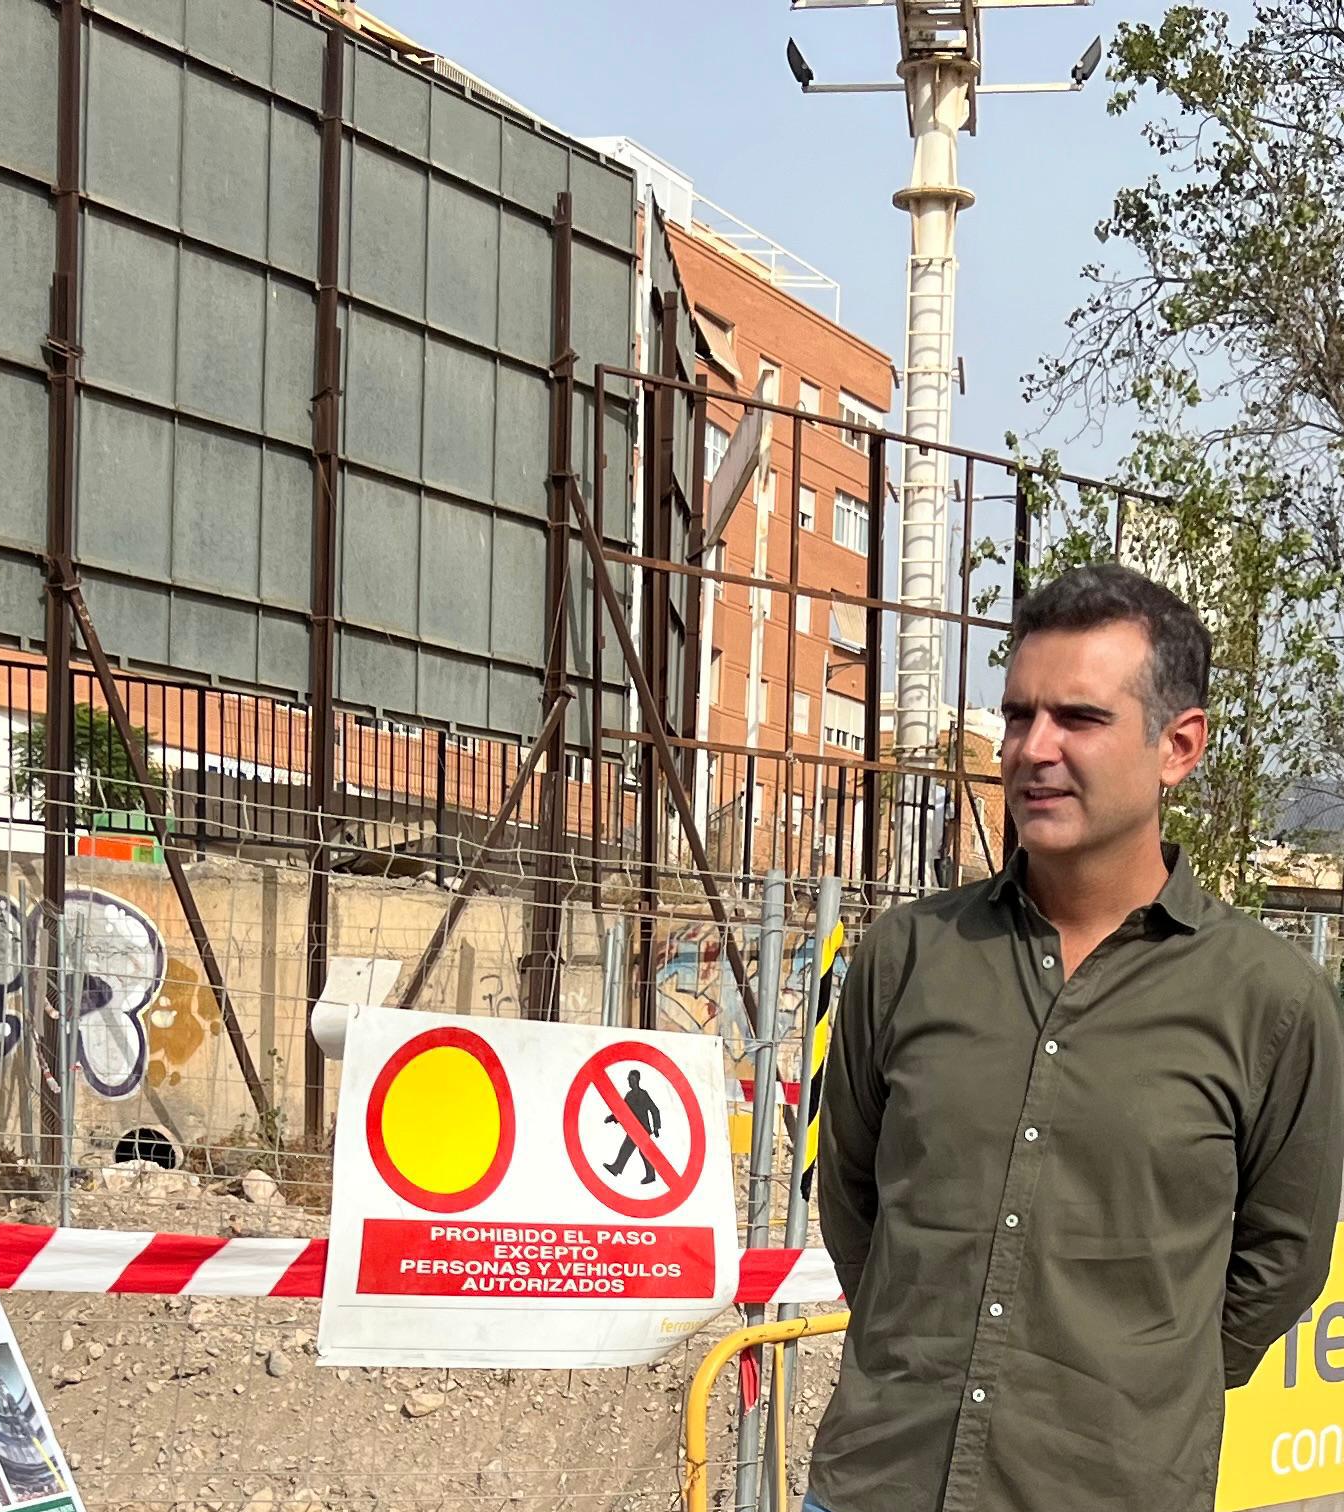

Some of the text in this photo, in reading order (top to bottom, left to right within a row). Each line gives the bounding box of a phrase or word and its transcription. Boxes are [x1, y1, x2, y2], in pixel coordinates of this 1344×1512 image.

[430, 1227, 657, 1246] PROHIBIDO EL PASO
[494, 1245, 598, 1260] EXCEPTO
[399, 1260, 682, 1278] PERSONAS Y VEHICULOS
[460, 1278, 625, 1293] AUTORIZADOS
